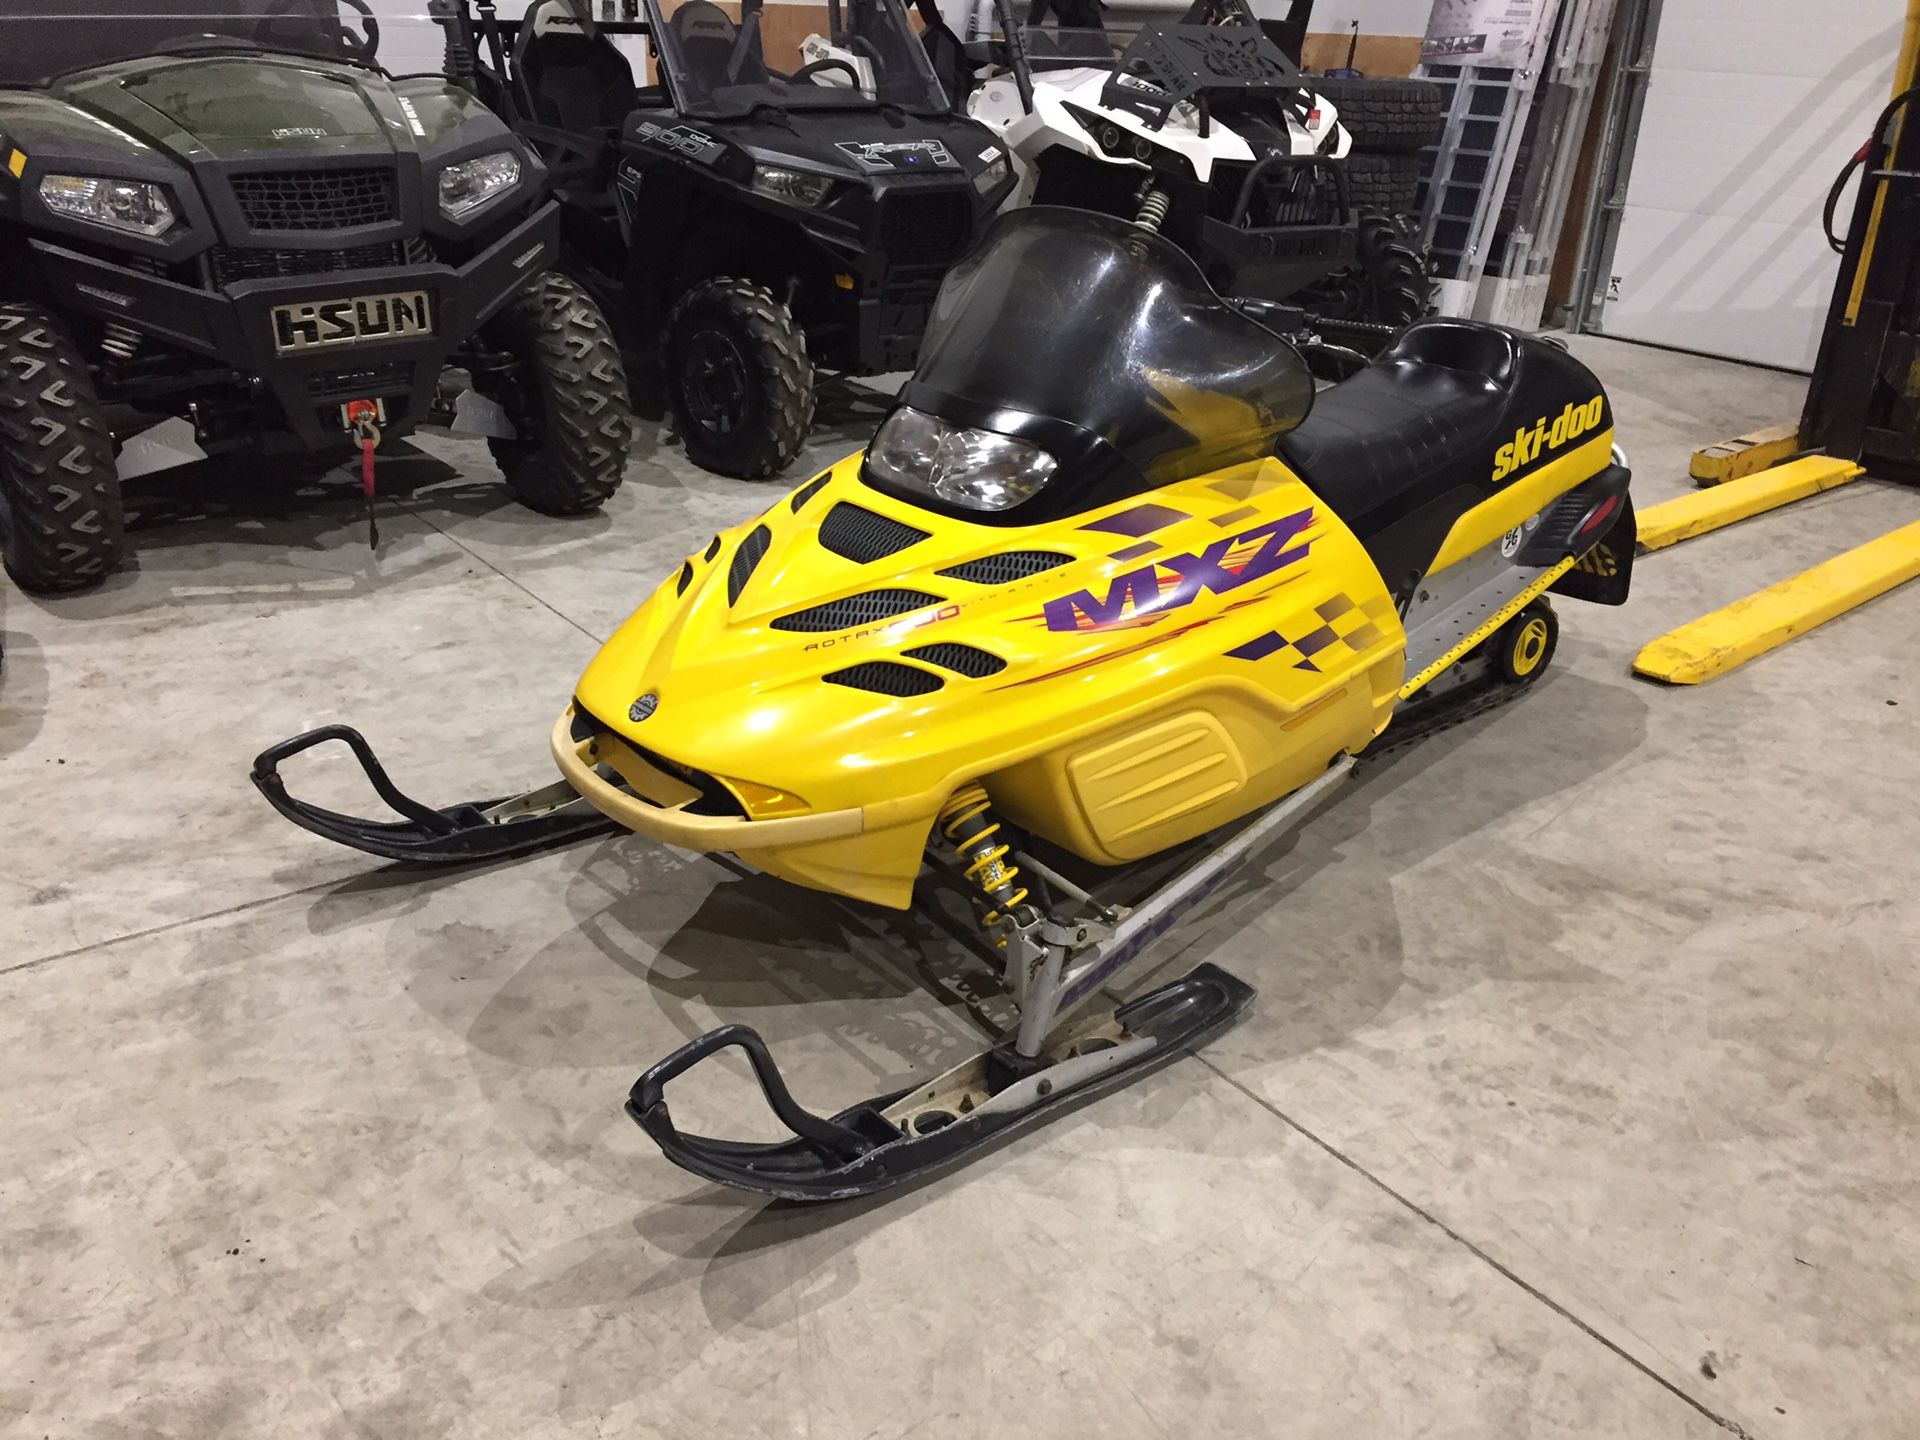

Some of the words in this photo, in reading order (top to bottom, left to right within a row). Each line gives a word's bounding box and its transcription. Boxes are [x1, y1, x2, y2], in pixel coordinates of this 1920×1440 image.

[275, 295, 427, 346] HSUN
[1491, 394, 1603, 482] ski-doo
[1043, 506, 1314, 632] MXZ
[803, 625, 884, 652] ROTAX
